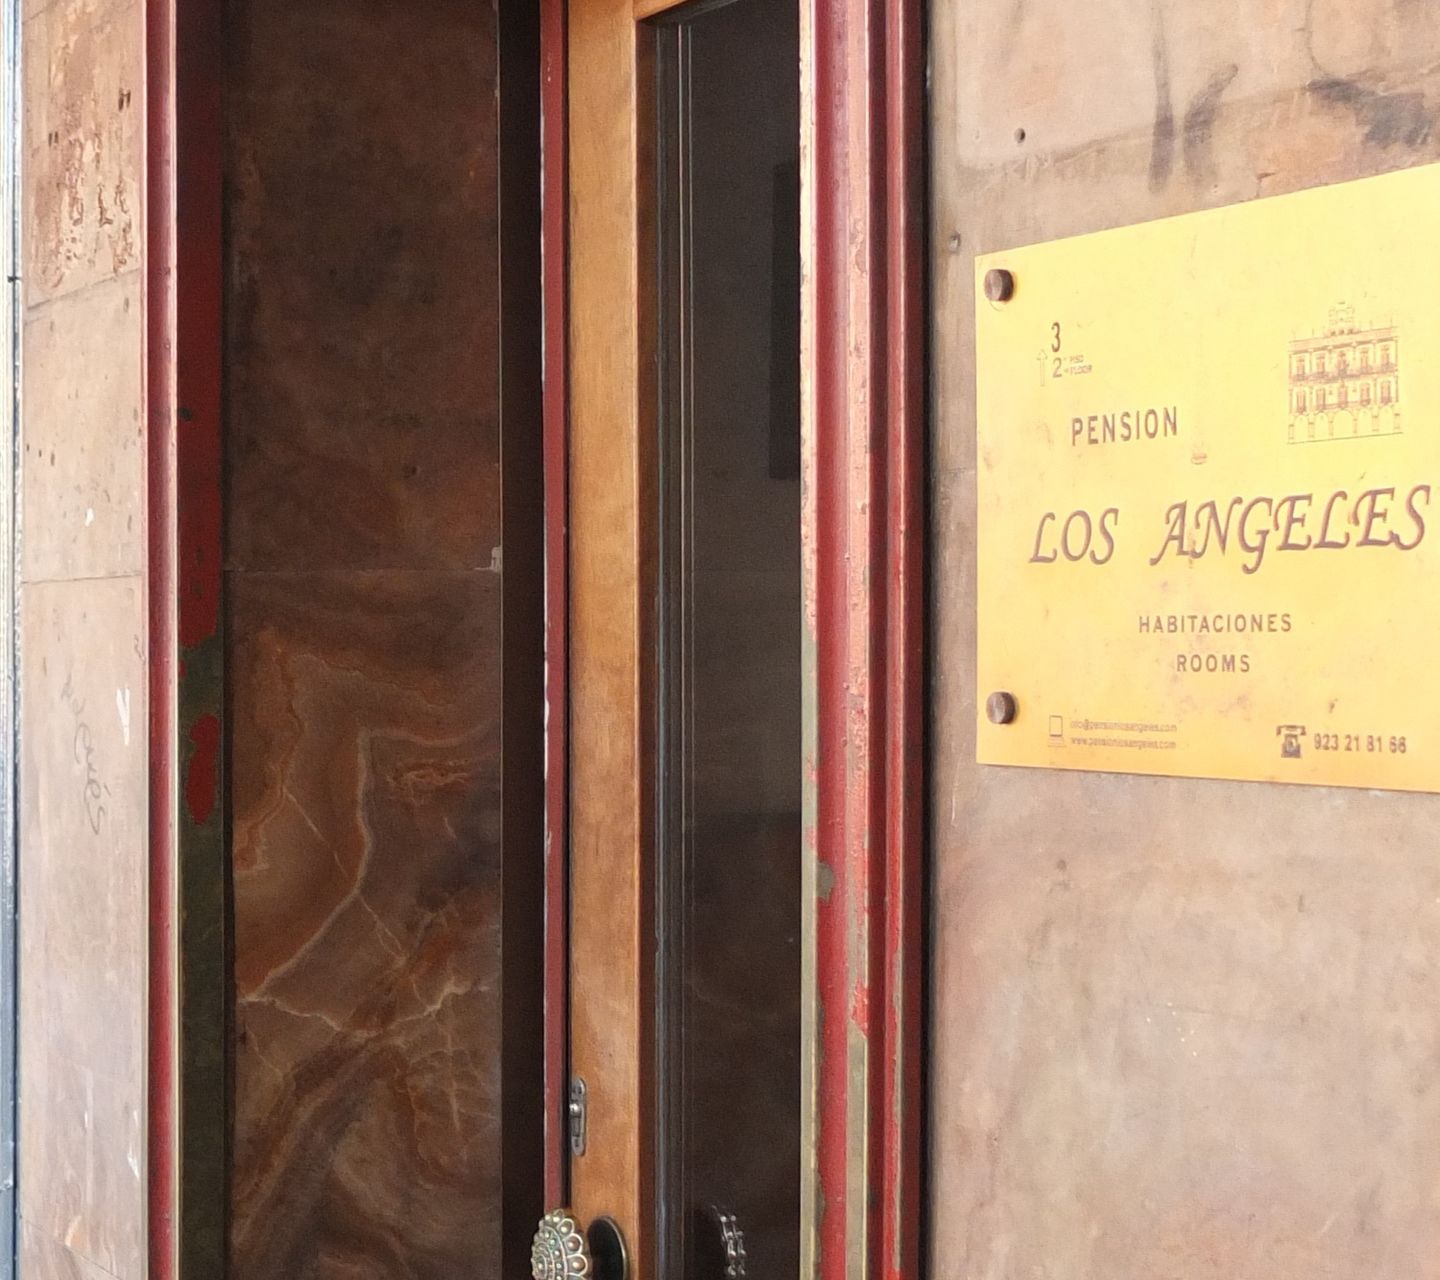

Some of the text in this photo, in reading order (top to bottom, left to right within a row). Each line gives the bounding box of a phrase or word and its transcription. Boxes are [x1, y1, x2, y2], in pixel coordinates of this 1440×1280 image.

[1051, 321, 1061, 353] 3
[1071, 406, 1179, 447] PENSION
[1029, 484, 1431, 575] LOS ANGELES
[1138, 612, 1293, 634] HABITACIONES
[1176, 653, 1251, 674] ROOMS
[1314, 733, 1339, 751] 923
[1344, 734, 1361, 752] 21
[1366, 735, 1383, 752] 81
